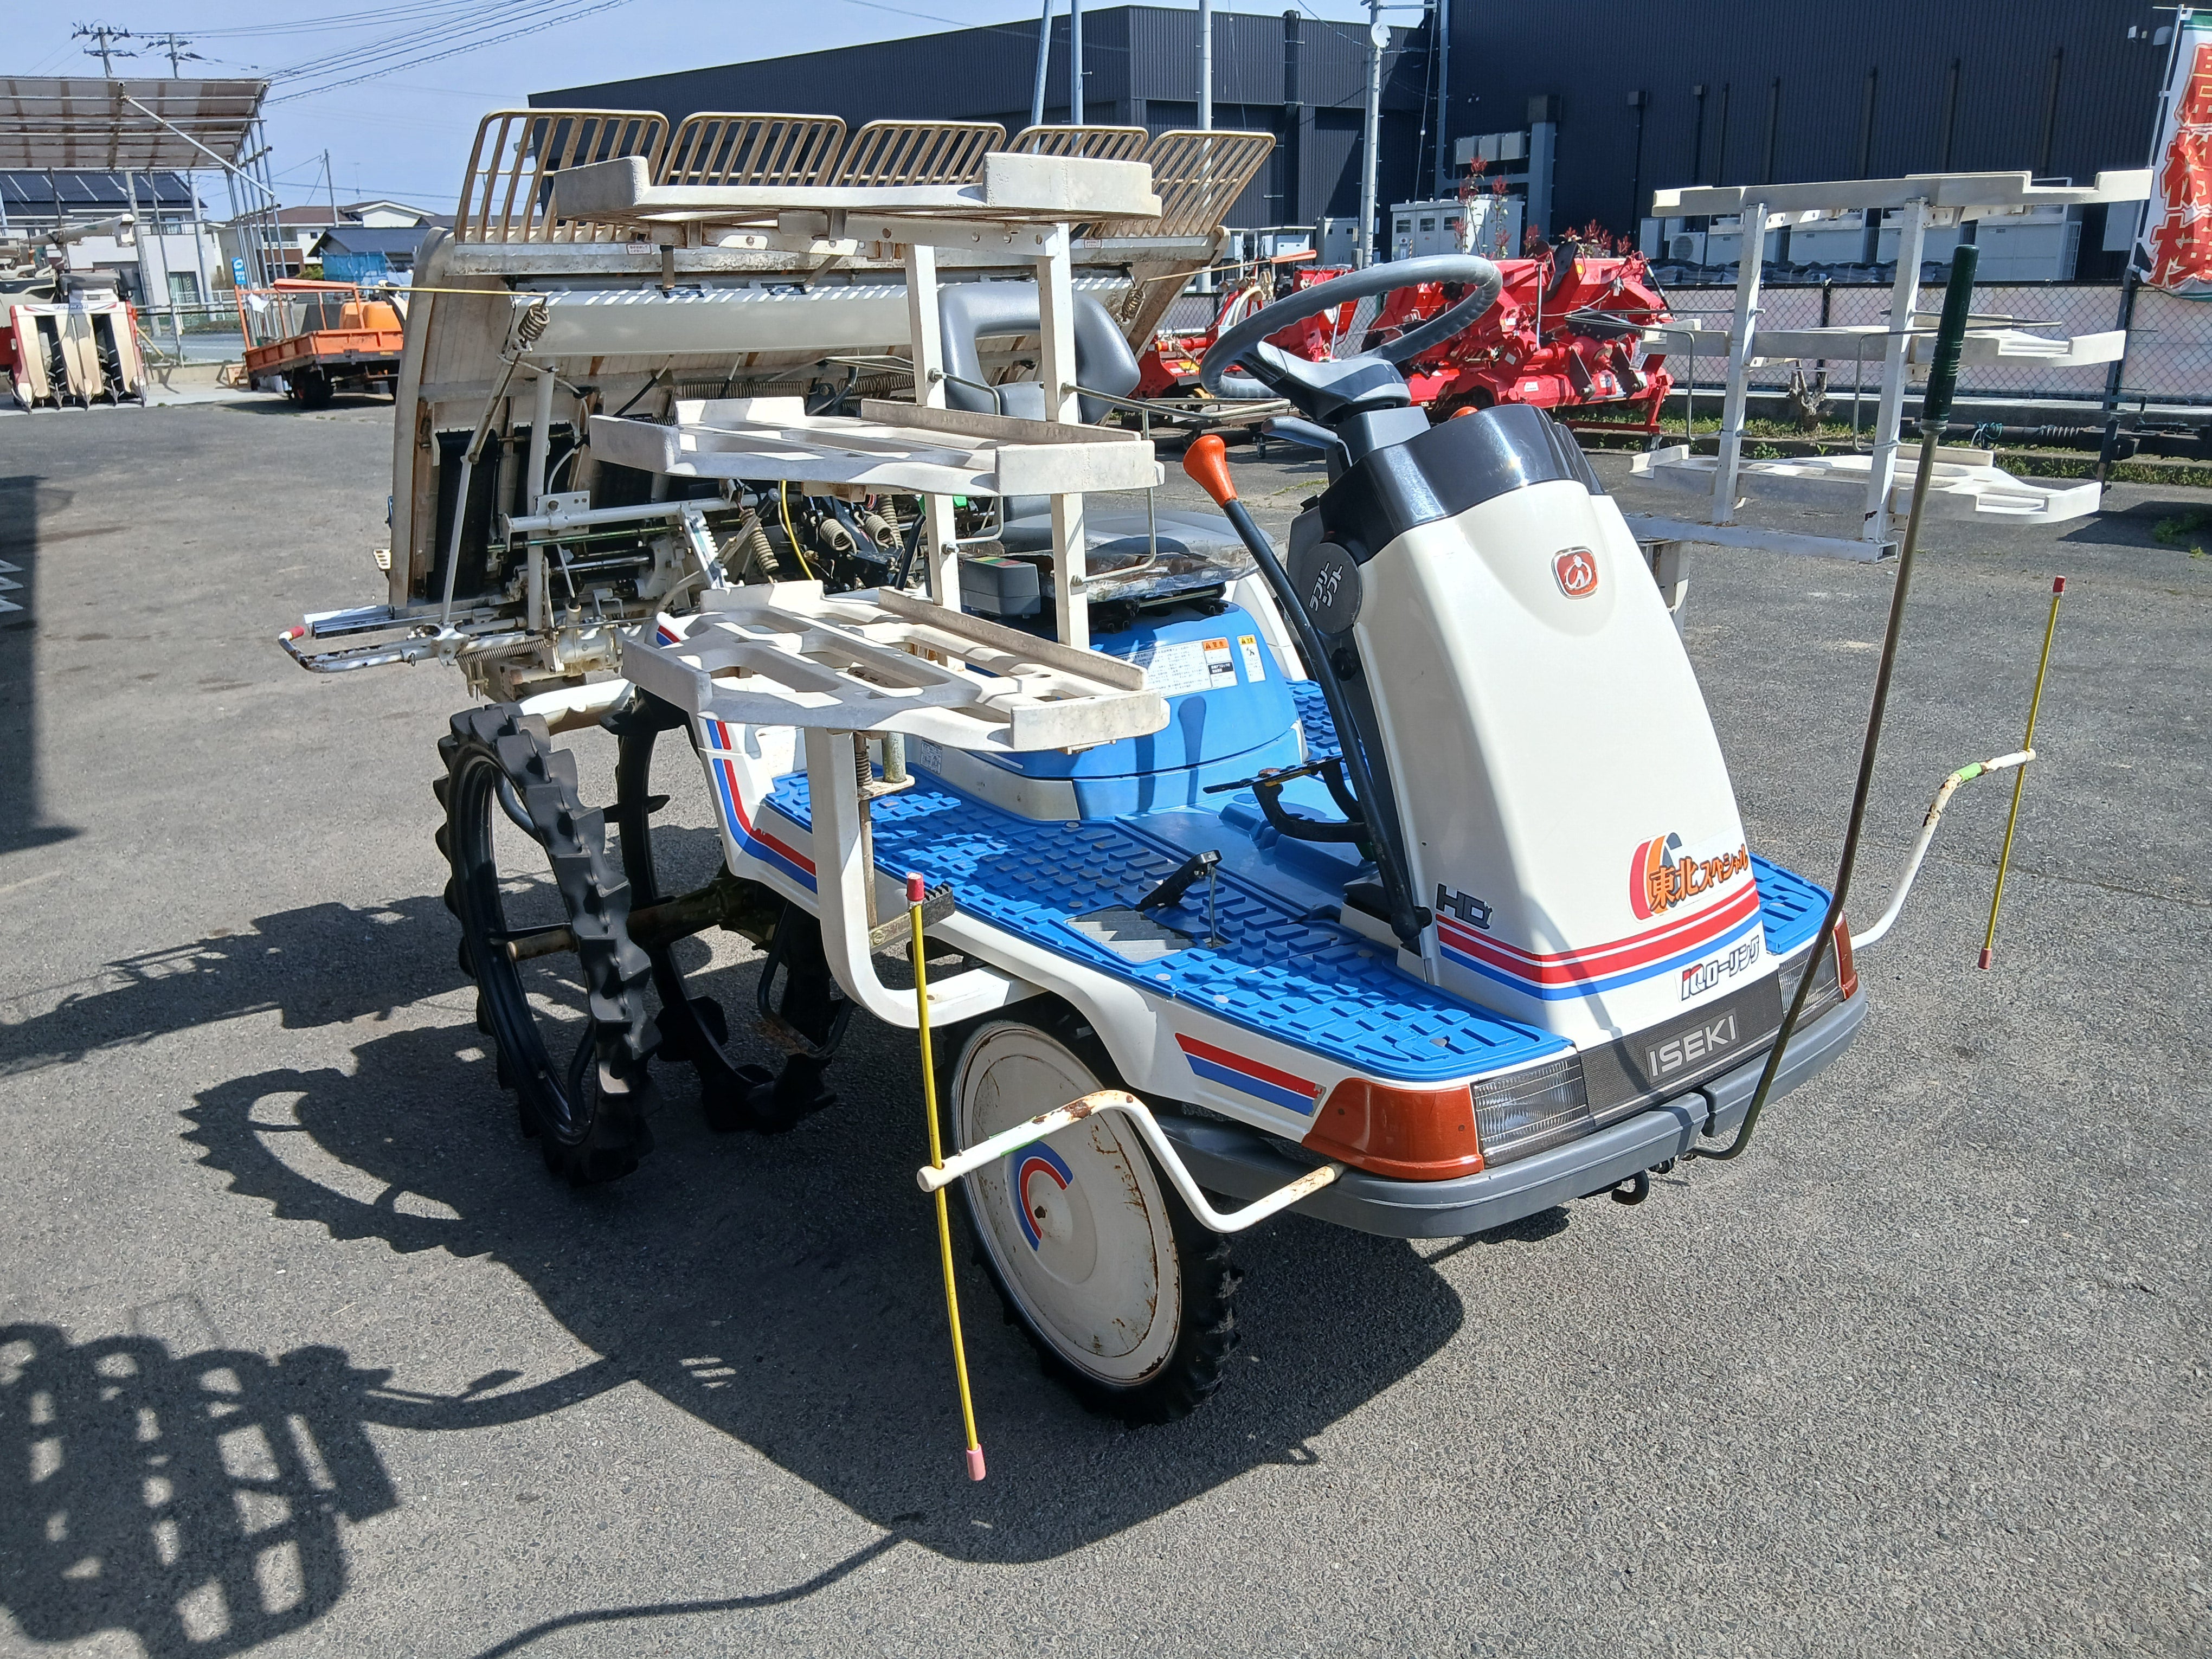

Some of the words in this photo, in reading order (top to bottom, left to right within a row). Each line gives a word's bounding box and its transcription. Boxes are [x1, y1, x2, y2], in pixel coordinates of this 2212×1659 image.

[1322, 565, 1342, 607] シフト
[1649, 843, 1748, 912] 東北スペシャル
[1436, 883, 1493, 929] HD
[1650, 1015, 1736, 1076] ISEKI
